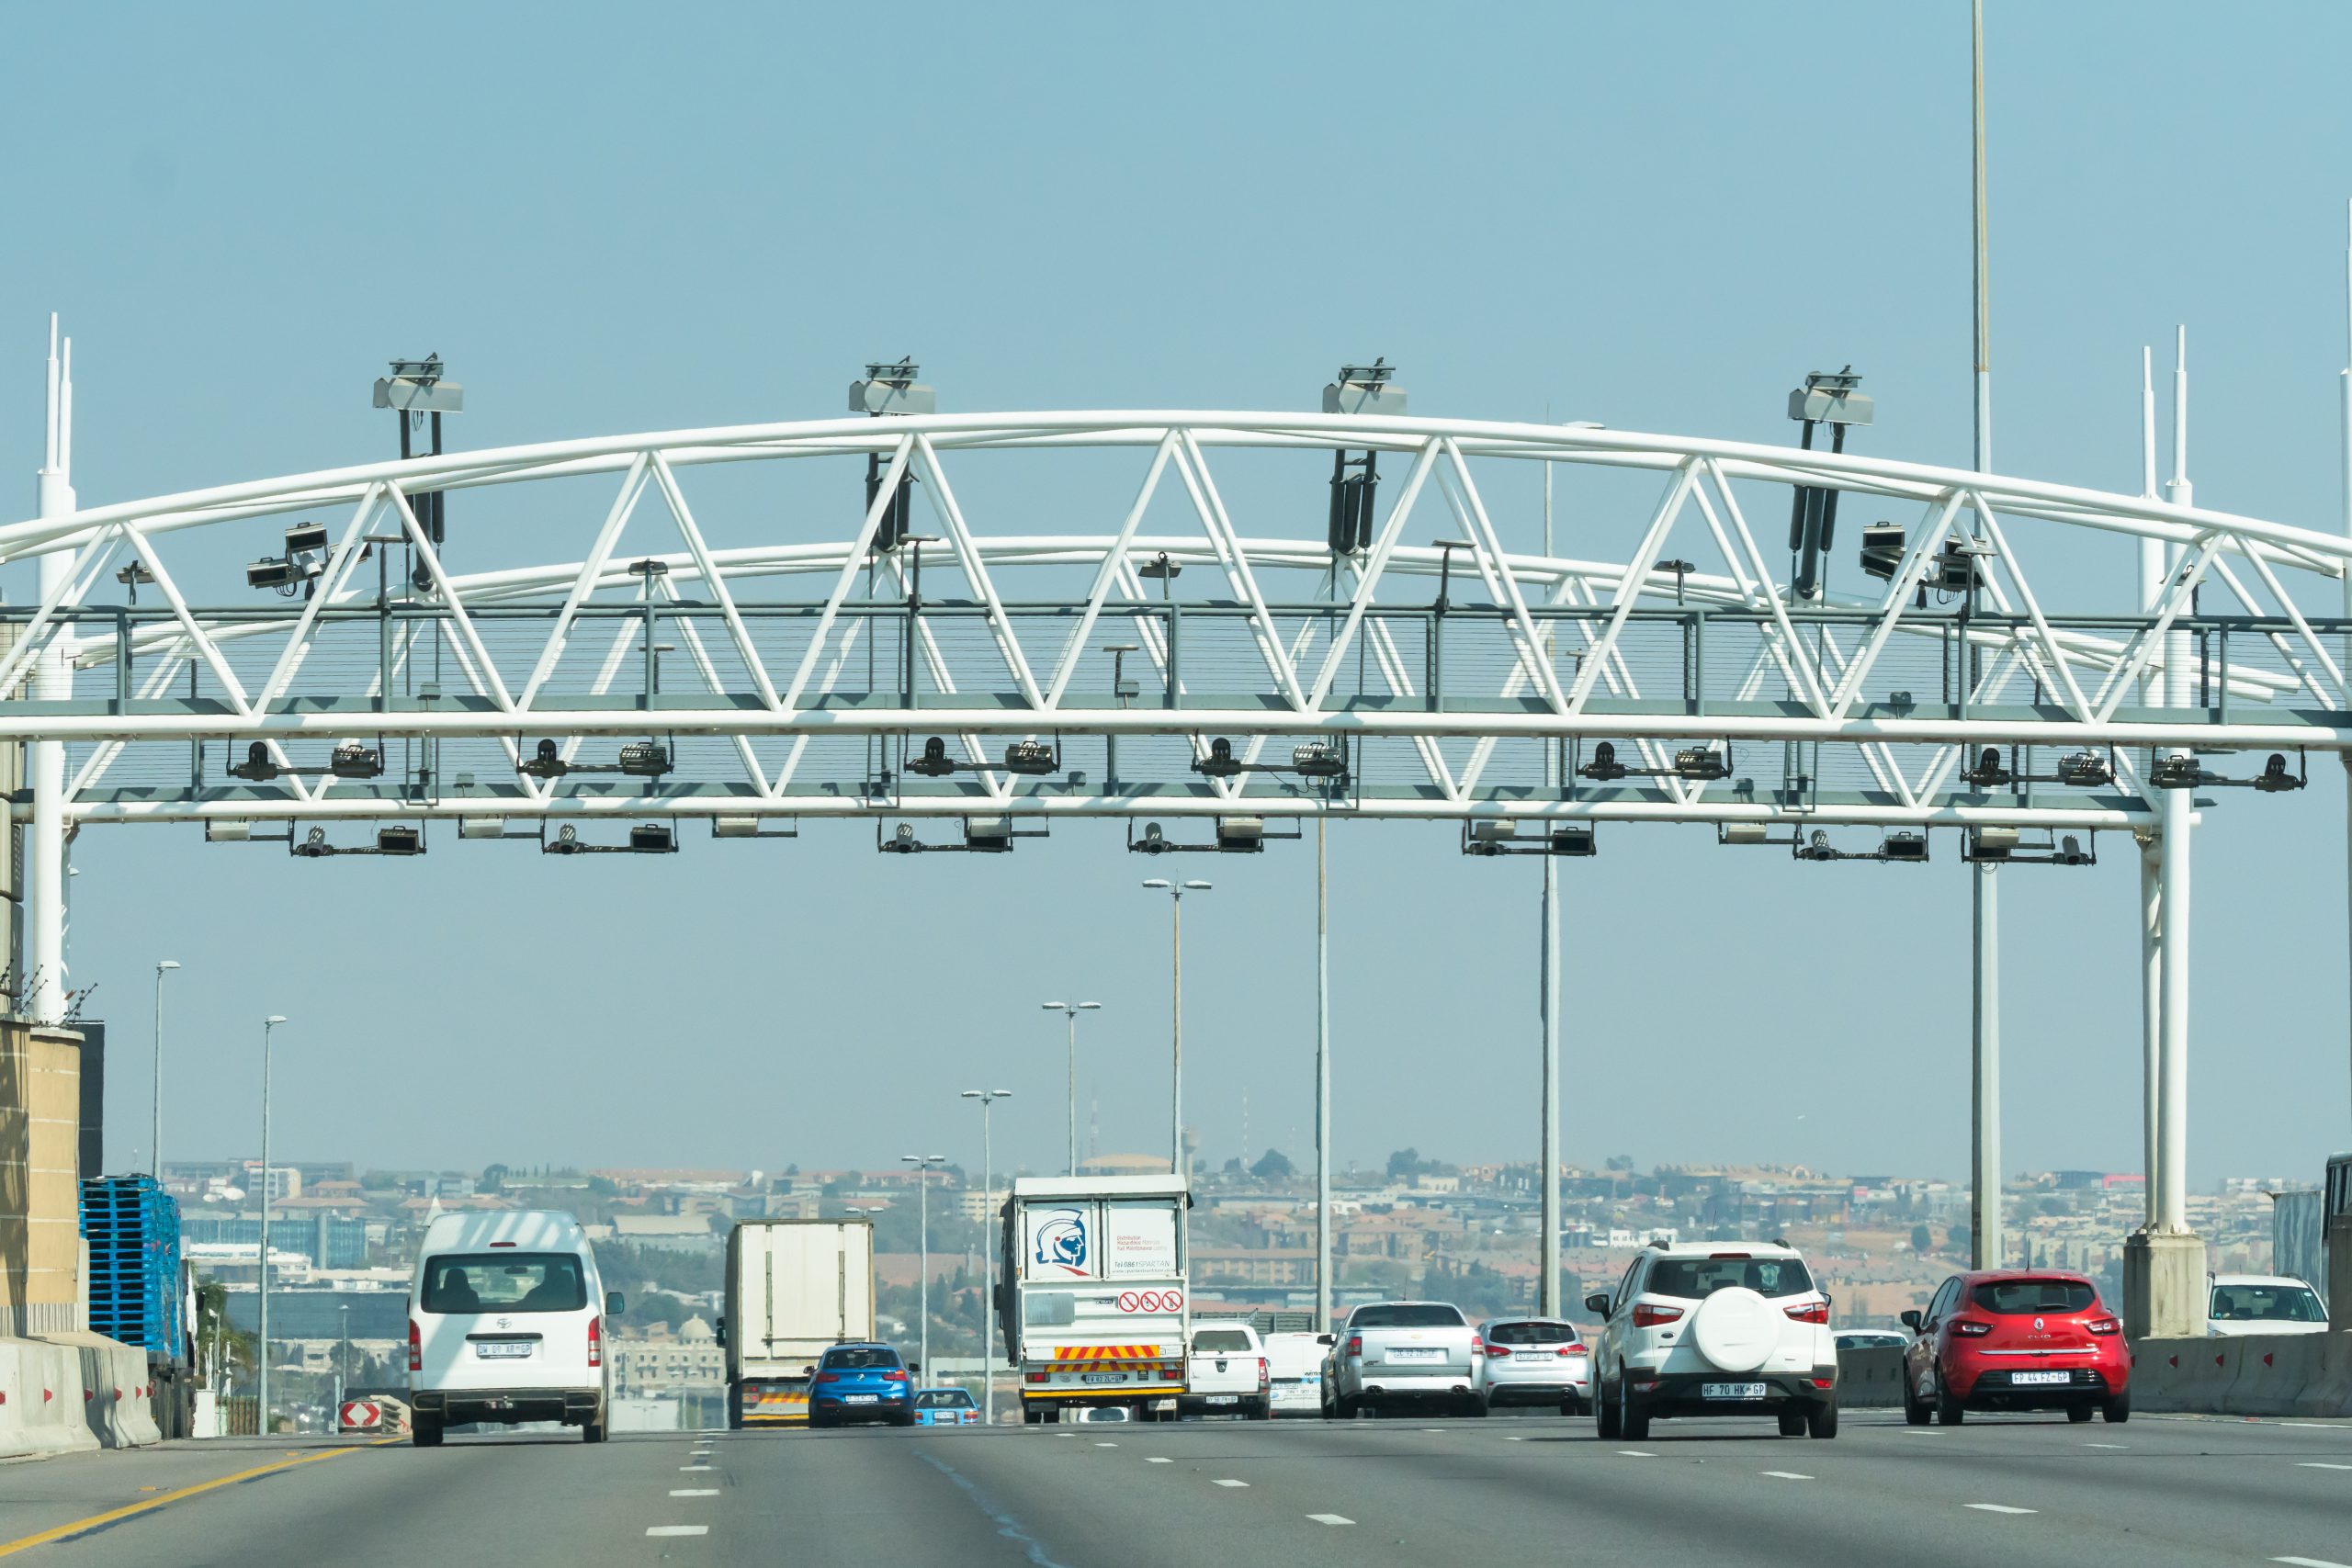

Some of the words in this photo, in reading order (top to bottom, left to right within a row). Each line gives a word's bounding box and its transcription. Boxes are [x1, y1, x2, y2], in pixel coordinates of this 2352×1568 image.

[2014, 1374, 2024, 1382] FP
[2028, 1373, 2037, 1382] 44
[2041, 1373, 2051, 1382] FZ
[2057, 1372, 2067, 1382] GP
[1703, 1385, 1713, 1395] HF
[1719, 1385, 1730, 1395] 70
[1734, 1385, 1746, 1394] HK
[1753, 1384, 1764, 1394] GP
